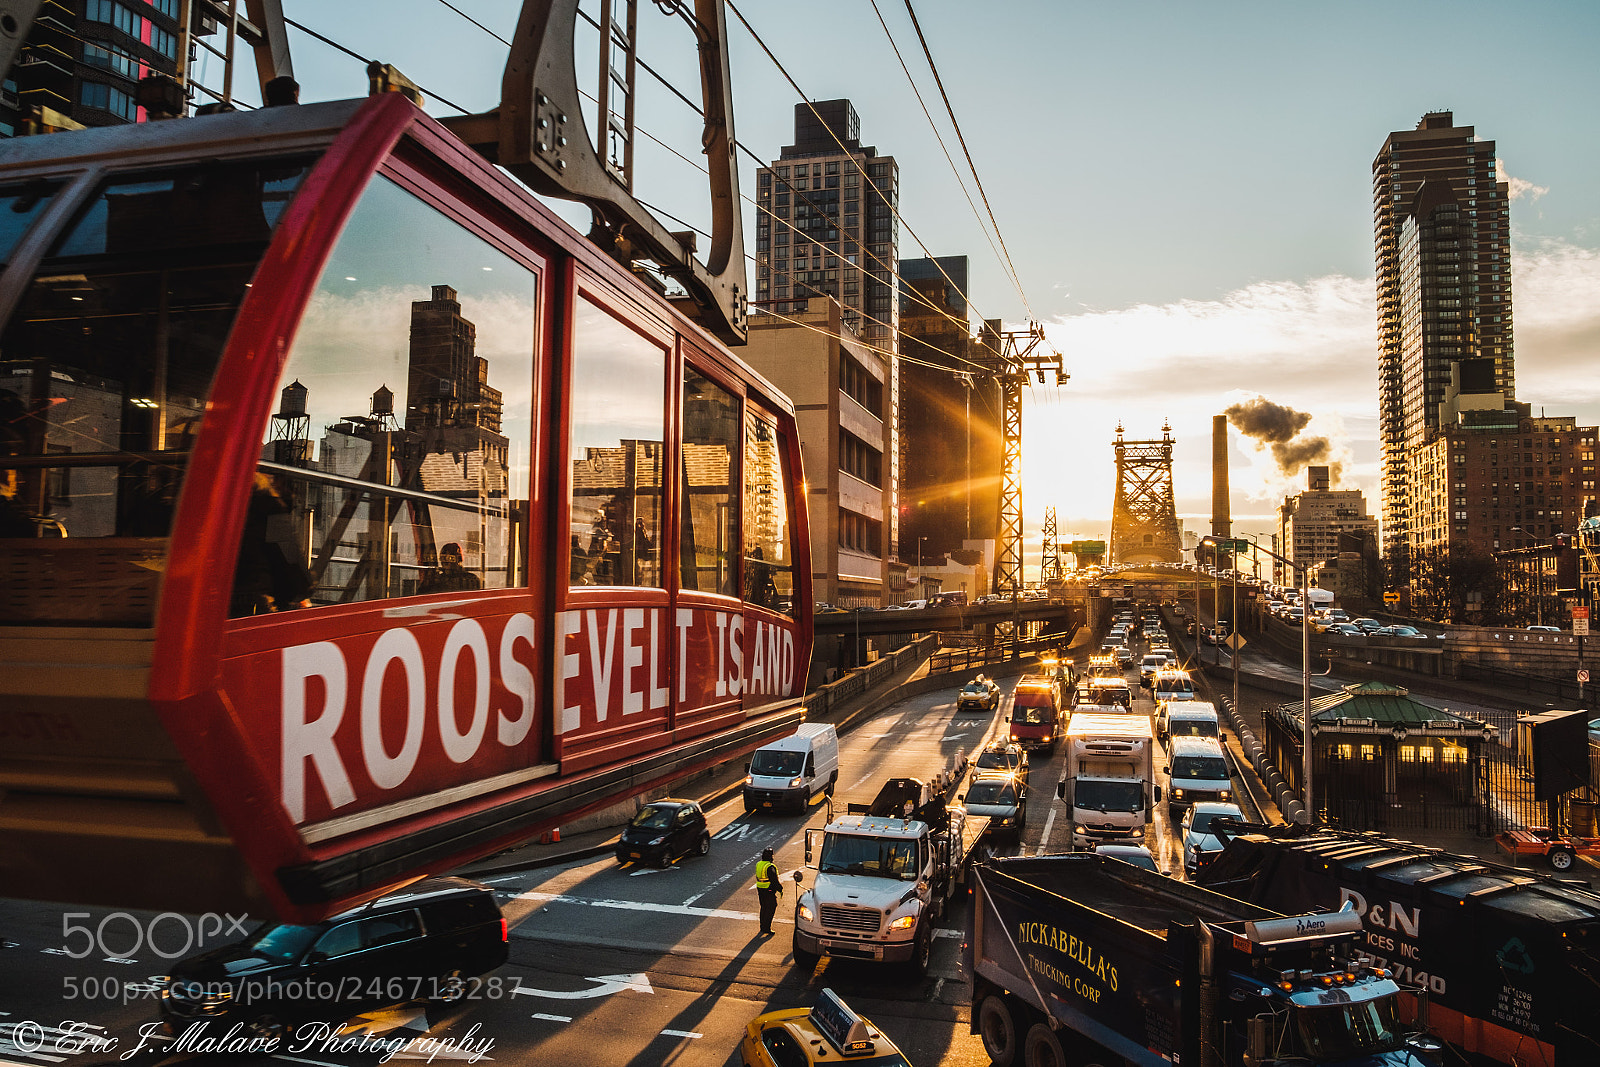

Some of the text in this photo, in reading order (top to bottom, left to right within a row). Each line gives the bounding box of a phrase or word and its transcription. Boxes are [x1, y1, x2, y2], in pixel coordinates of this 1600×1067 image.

[281, 608, 693, 824] ROOSEVELT
[1306, 919, 1326, 929] Aero
[1018, 922, 1118, 992] NICKABELLA'S
[1028, 953, 1101, 1004] TRUCKING CORP
